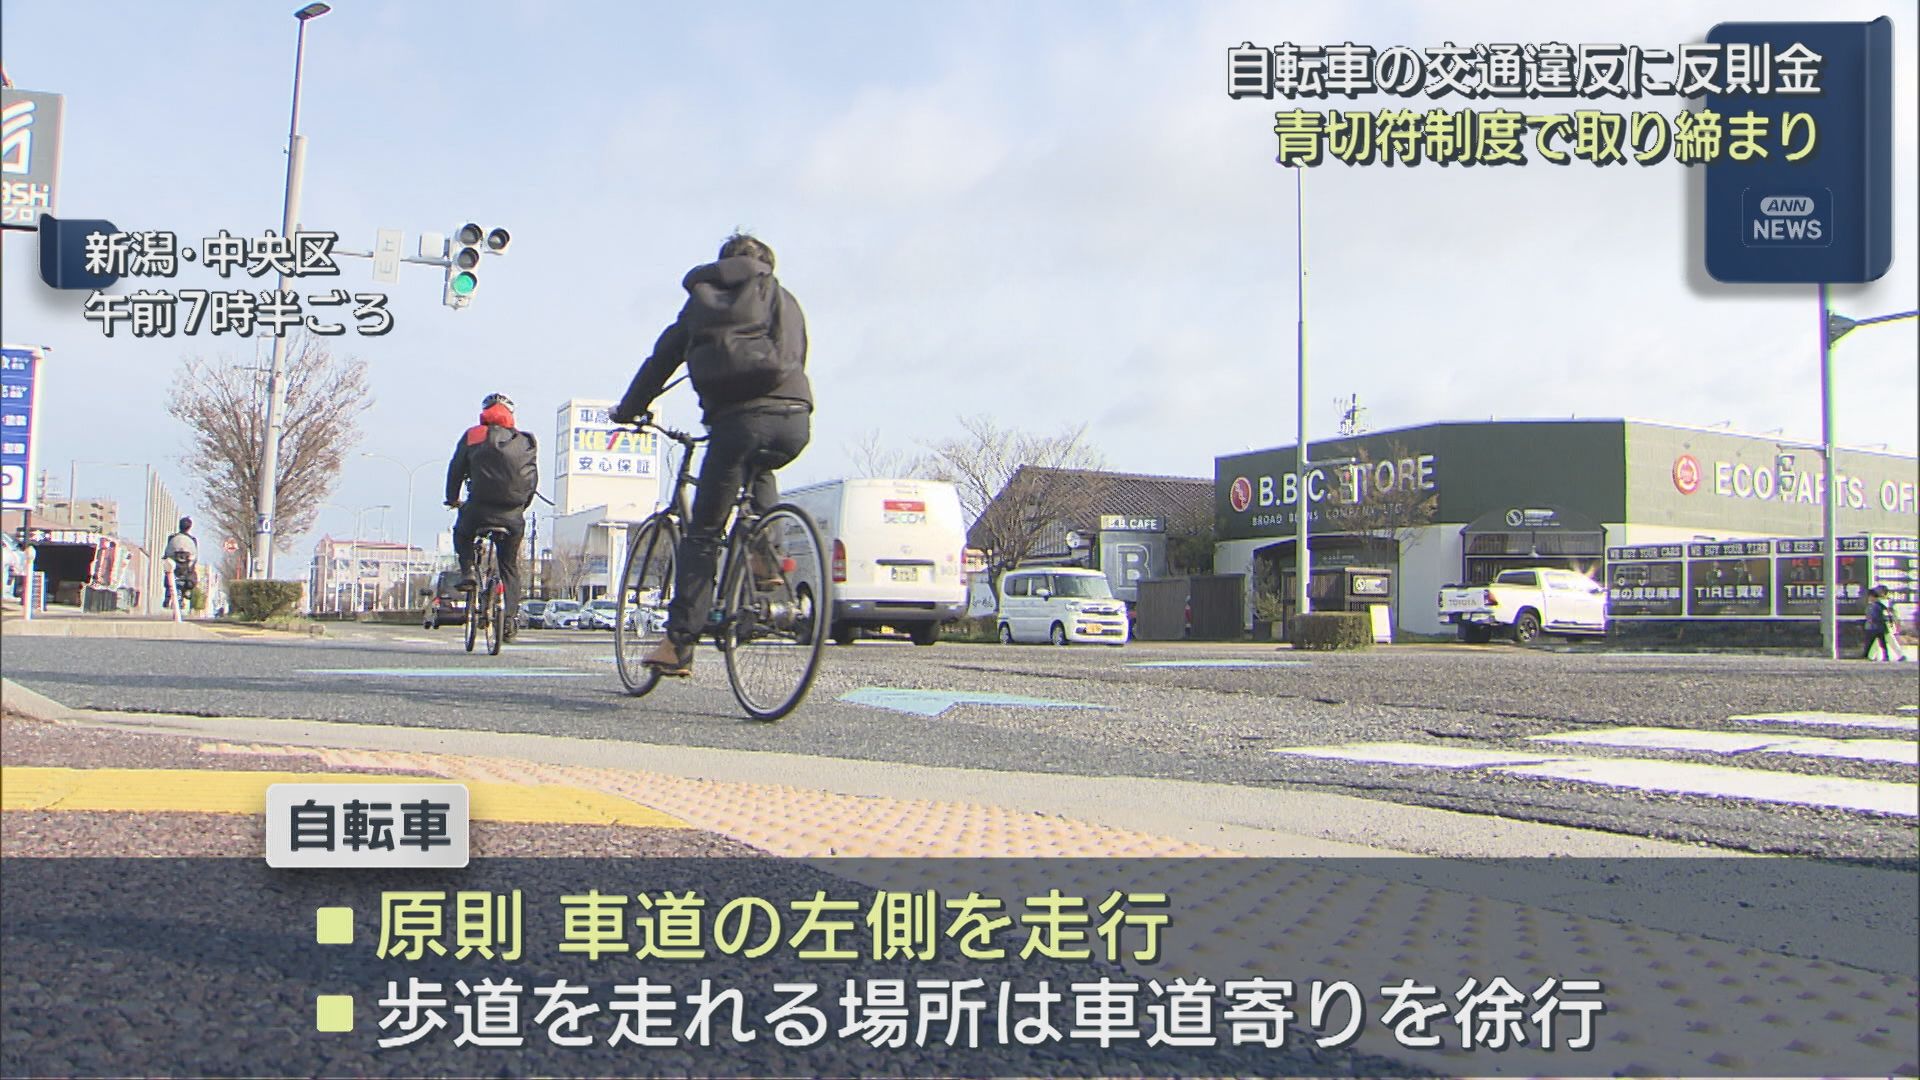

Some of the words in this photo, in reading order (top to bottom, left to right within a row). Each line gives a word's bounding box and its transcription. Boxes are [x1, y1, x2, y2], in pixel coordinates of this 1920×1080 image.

[581, 409, 614, 424] 車高
[1340, 455, 1435, 503] TORE
[1714, 461, 1773, 500] ECO
